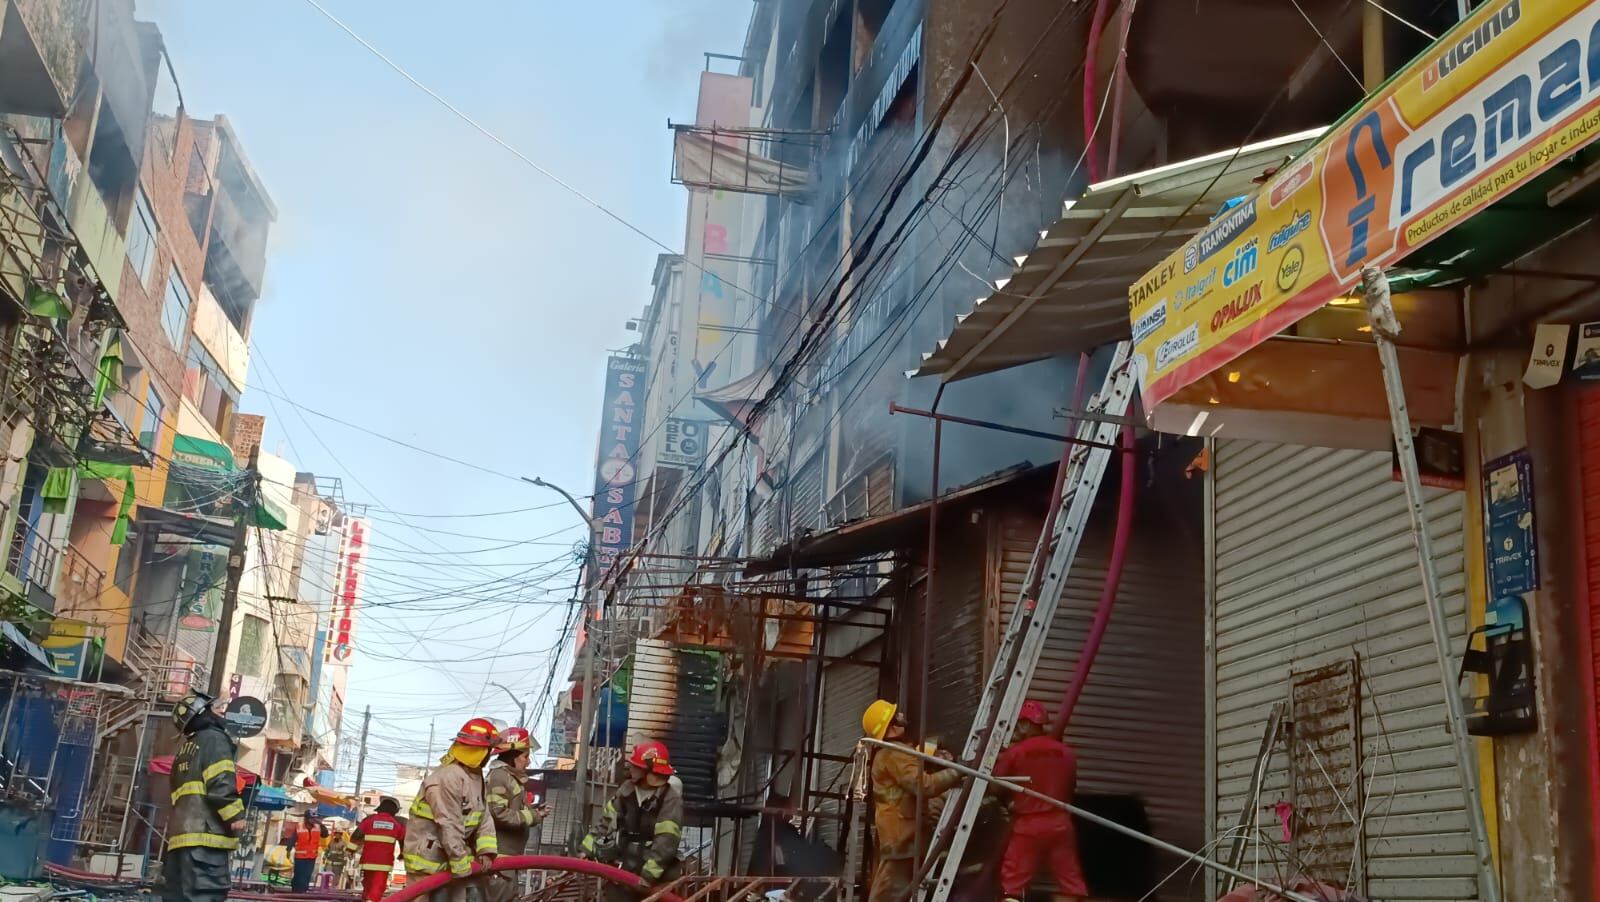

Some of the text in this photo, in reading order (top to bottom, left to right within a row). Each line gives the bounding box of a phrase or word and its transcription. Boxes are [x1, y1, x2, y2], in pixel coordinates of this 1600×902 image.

[1408, 209, 1449, 241] Productos
[1450, 201, 1461, 215] de
[1462, 178, 1494, 208] calidad
[1494, 168, 1515, 191] para
[1515, 159, 1527, 174] tu
[1528, 141, 1558, 166] hogar
[1560, 135, 1568, 146] e
[1200, 201, 1255, 256] TRAMONTINA
[1128, 261, 1176, 313] STANLEY
[1223, 246, 1258, 288] cim
[1281, 259, 1300, 280] Yale
[1210, 279, 1264, 333] OPALUX
[607, 373, 636, 460] SANTA
[1495, 552, 1522, 566] TRAVEX
